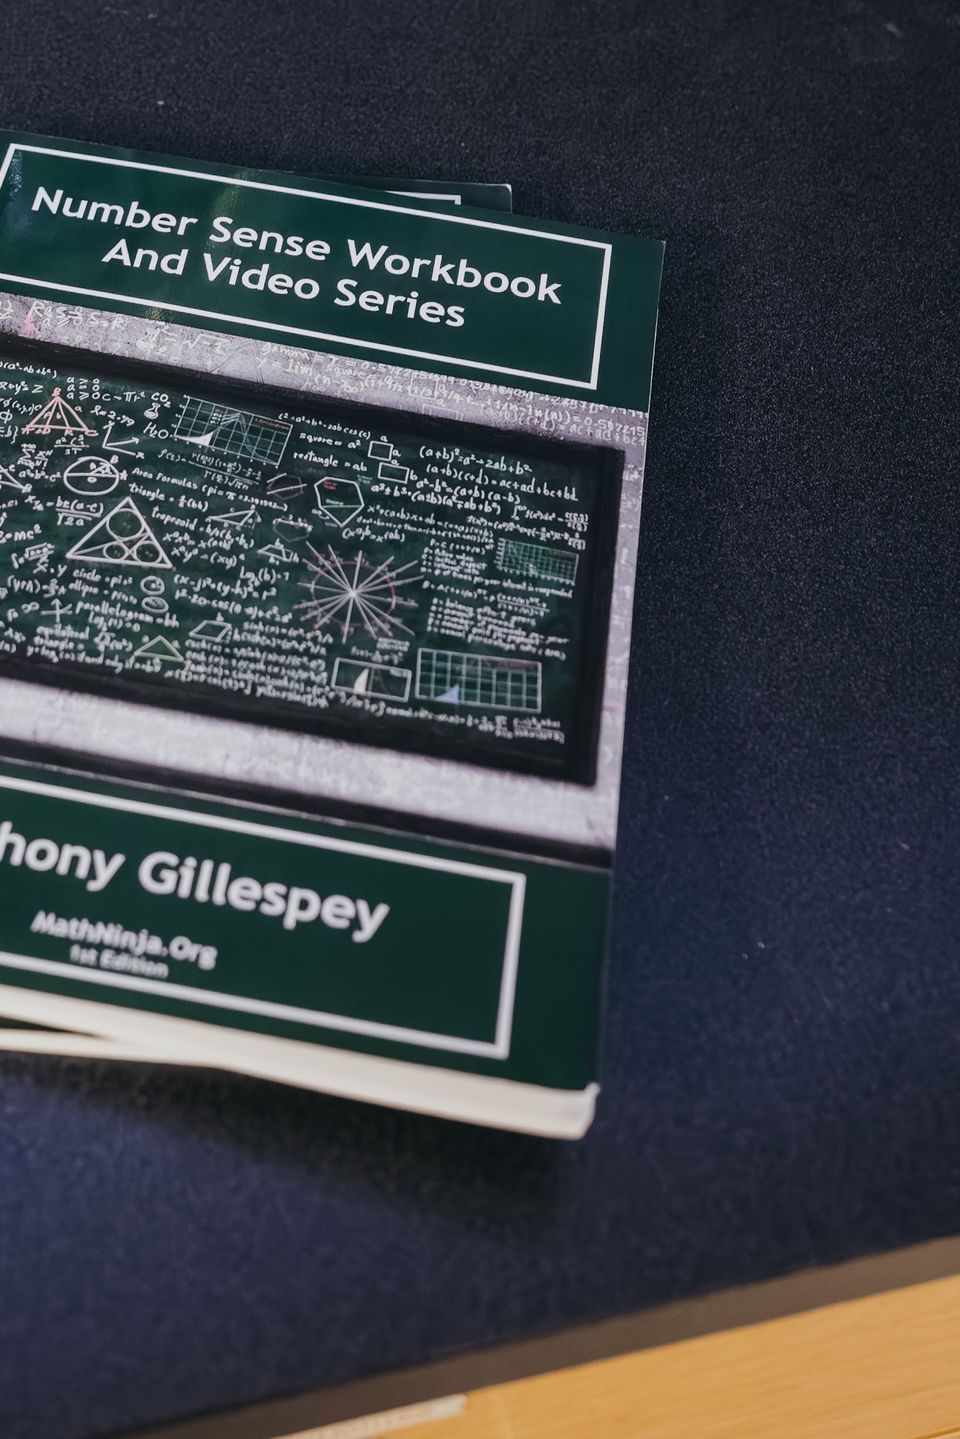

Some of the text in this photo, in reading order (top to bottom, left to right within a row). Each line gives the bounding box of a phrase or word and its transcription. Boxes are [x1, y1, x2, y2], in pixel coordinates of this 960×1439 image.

[30, 186, 562, 305] Number Sense Workbook
[101, 238, 466, 328] And Video Series
[29, 909, 218, 971] MathNinja.Org
[138, 851, 391, 943] Gillespey
[69, 943, 170, 979] 1st Edition
